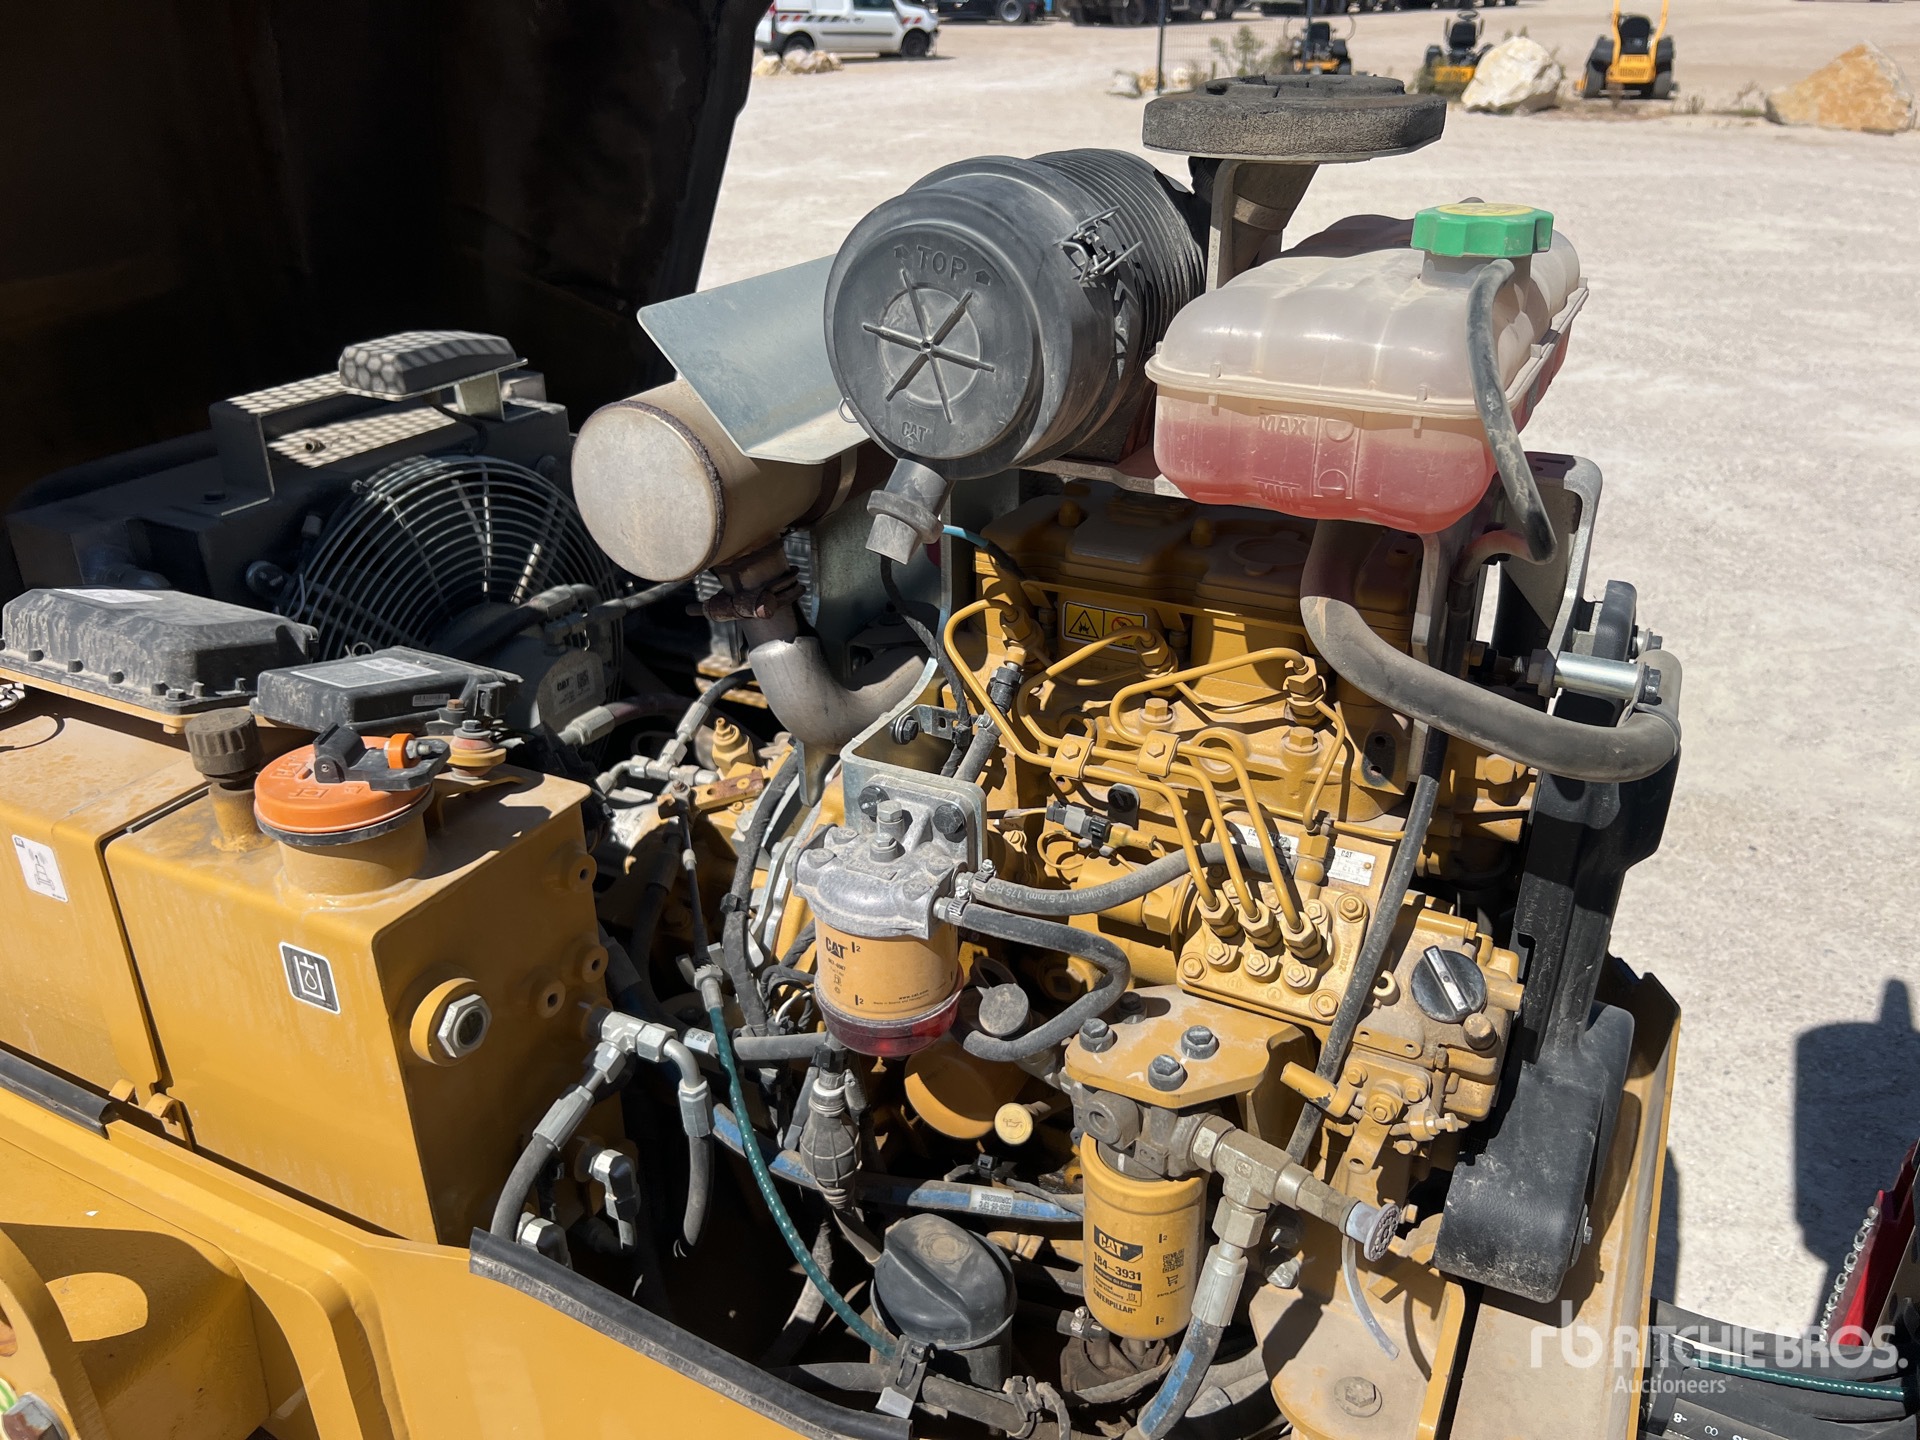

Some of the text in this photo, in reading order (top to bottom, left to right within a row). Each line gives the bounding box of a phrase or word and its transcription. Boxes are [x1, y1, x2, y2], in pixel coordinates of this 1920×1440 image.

[916, 244, 969, 281] TOP
[901, 421, 929, 443] CAT
[1258, 414, 1307, 436] MAX
[1340, 849, 1353, 859] CAT
[1005, 888, 1022, 899] 175
[825, 936, 846, 960] CAT
[1098, 1232, 1123, 1258] CAT
[1093, 1287, 1134, 1314] CATERPILLAR
